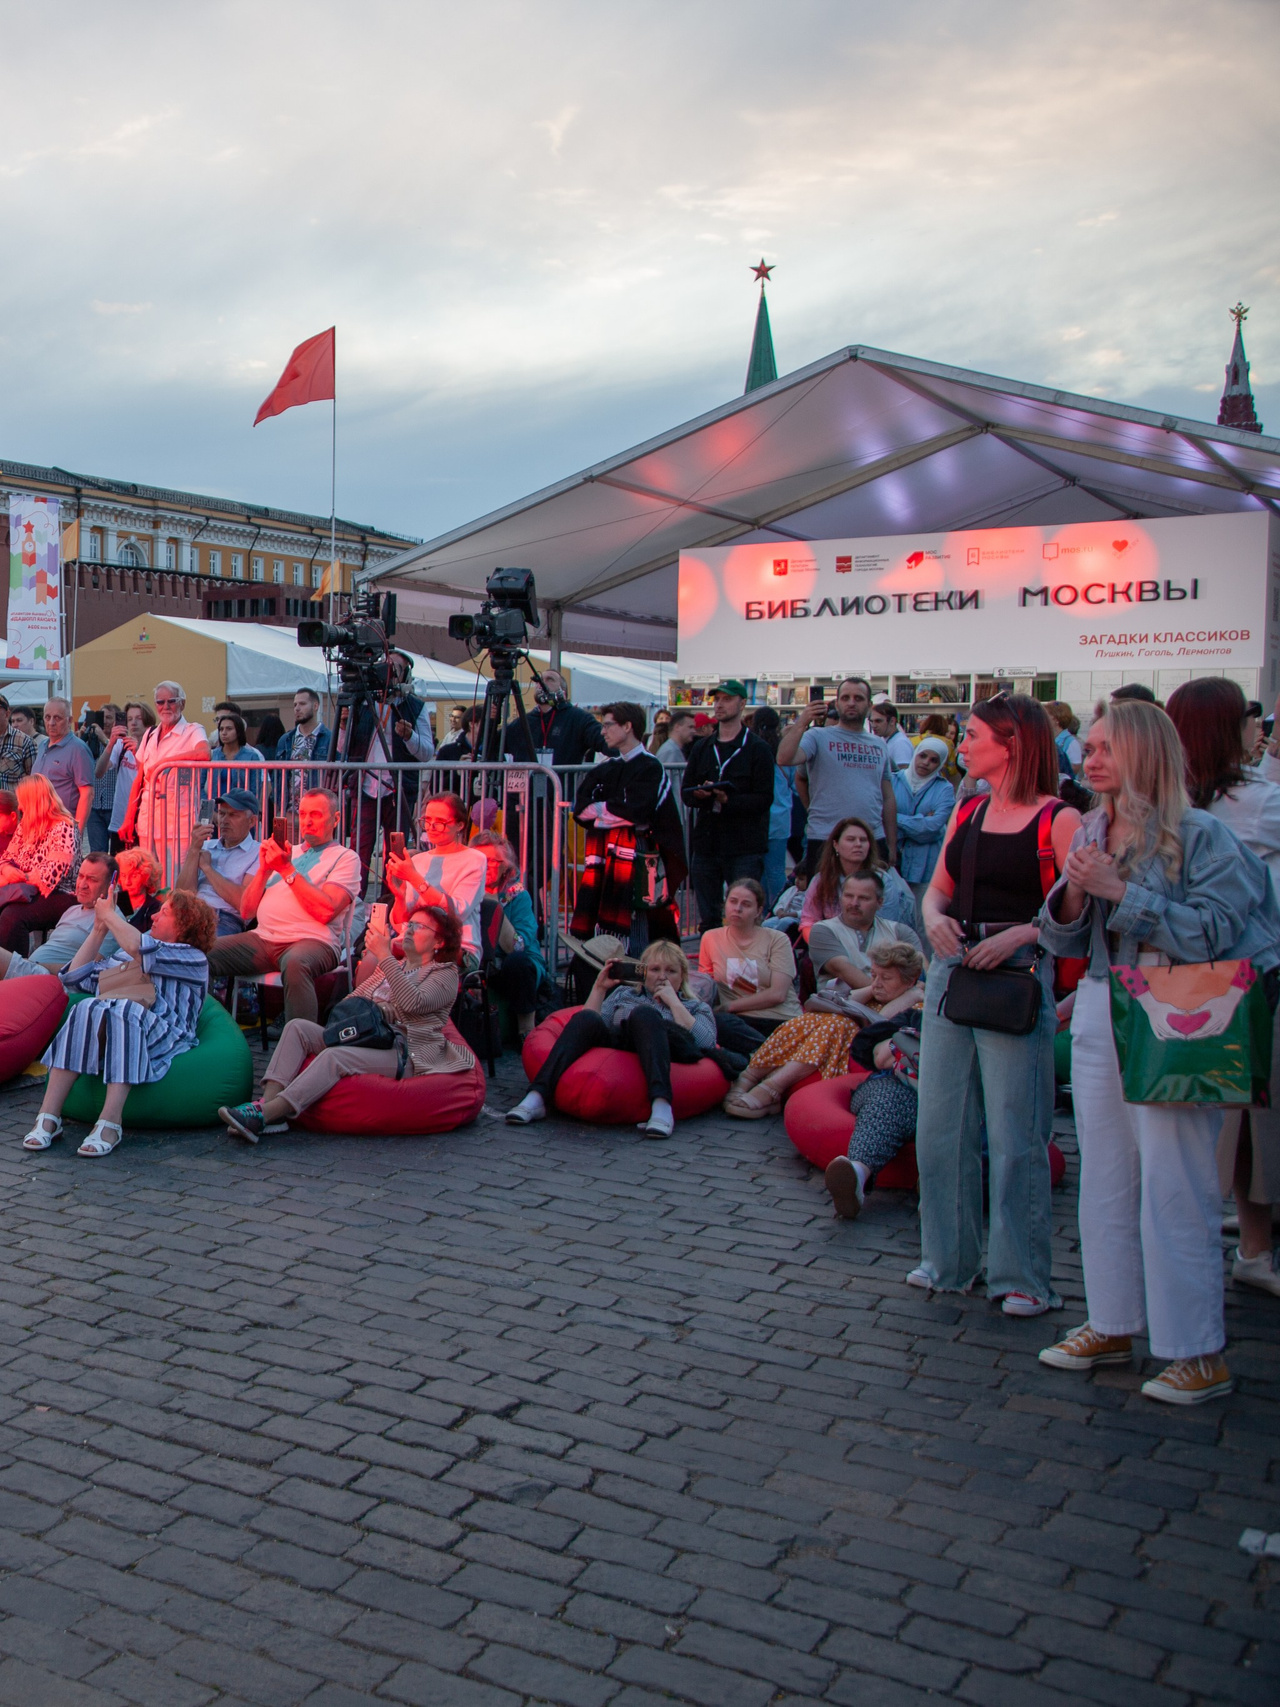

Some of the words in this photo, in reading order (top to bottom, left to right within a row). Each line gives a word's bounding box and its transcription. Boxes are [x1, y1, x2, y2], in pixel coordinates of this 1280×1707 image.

[1061, 545, 1094, 554] mos.ru
[744, 590, 979, 621] БИБЛИОТЕКИ
[1021, 578, 1199, 608] МОСКВЫ
[1078, 633, 1149, 646] ЗАГАДКИ
[1153, 630, 1251, 643] КЛАССИКОВ
[838, 753, 880, 764] IMPERFECT
